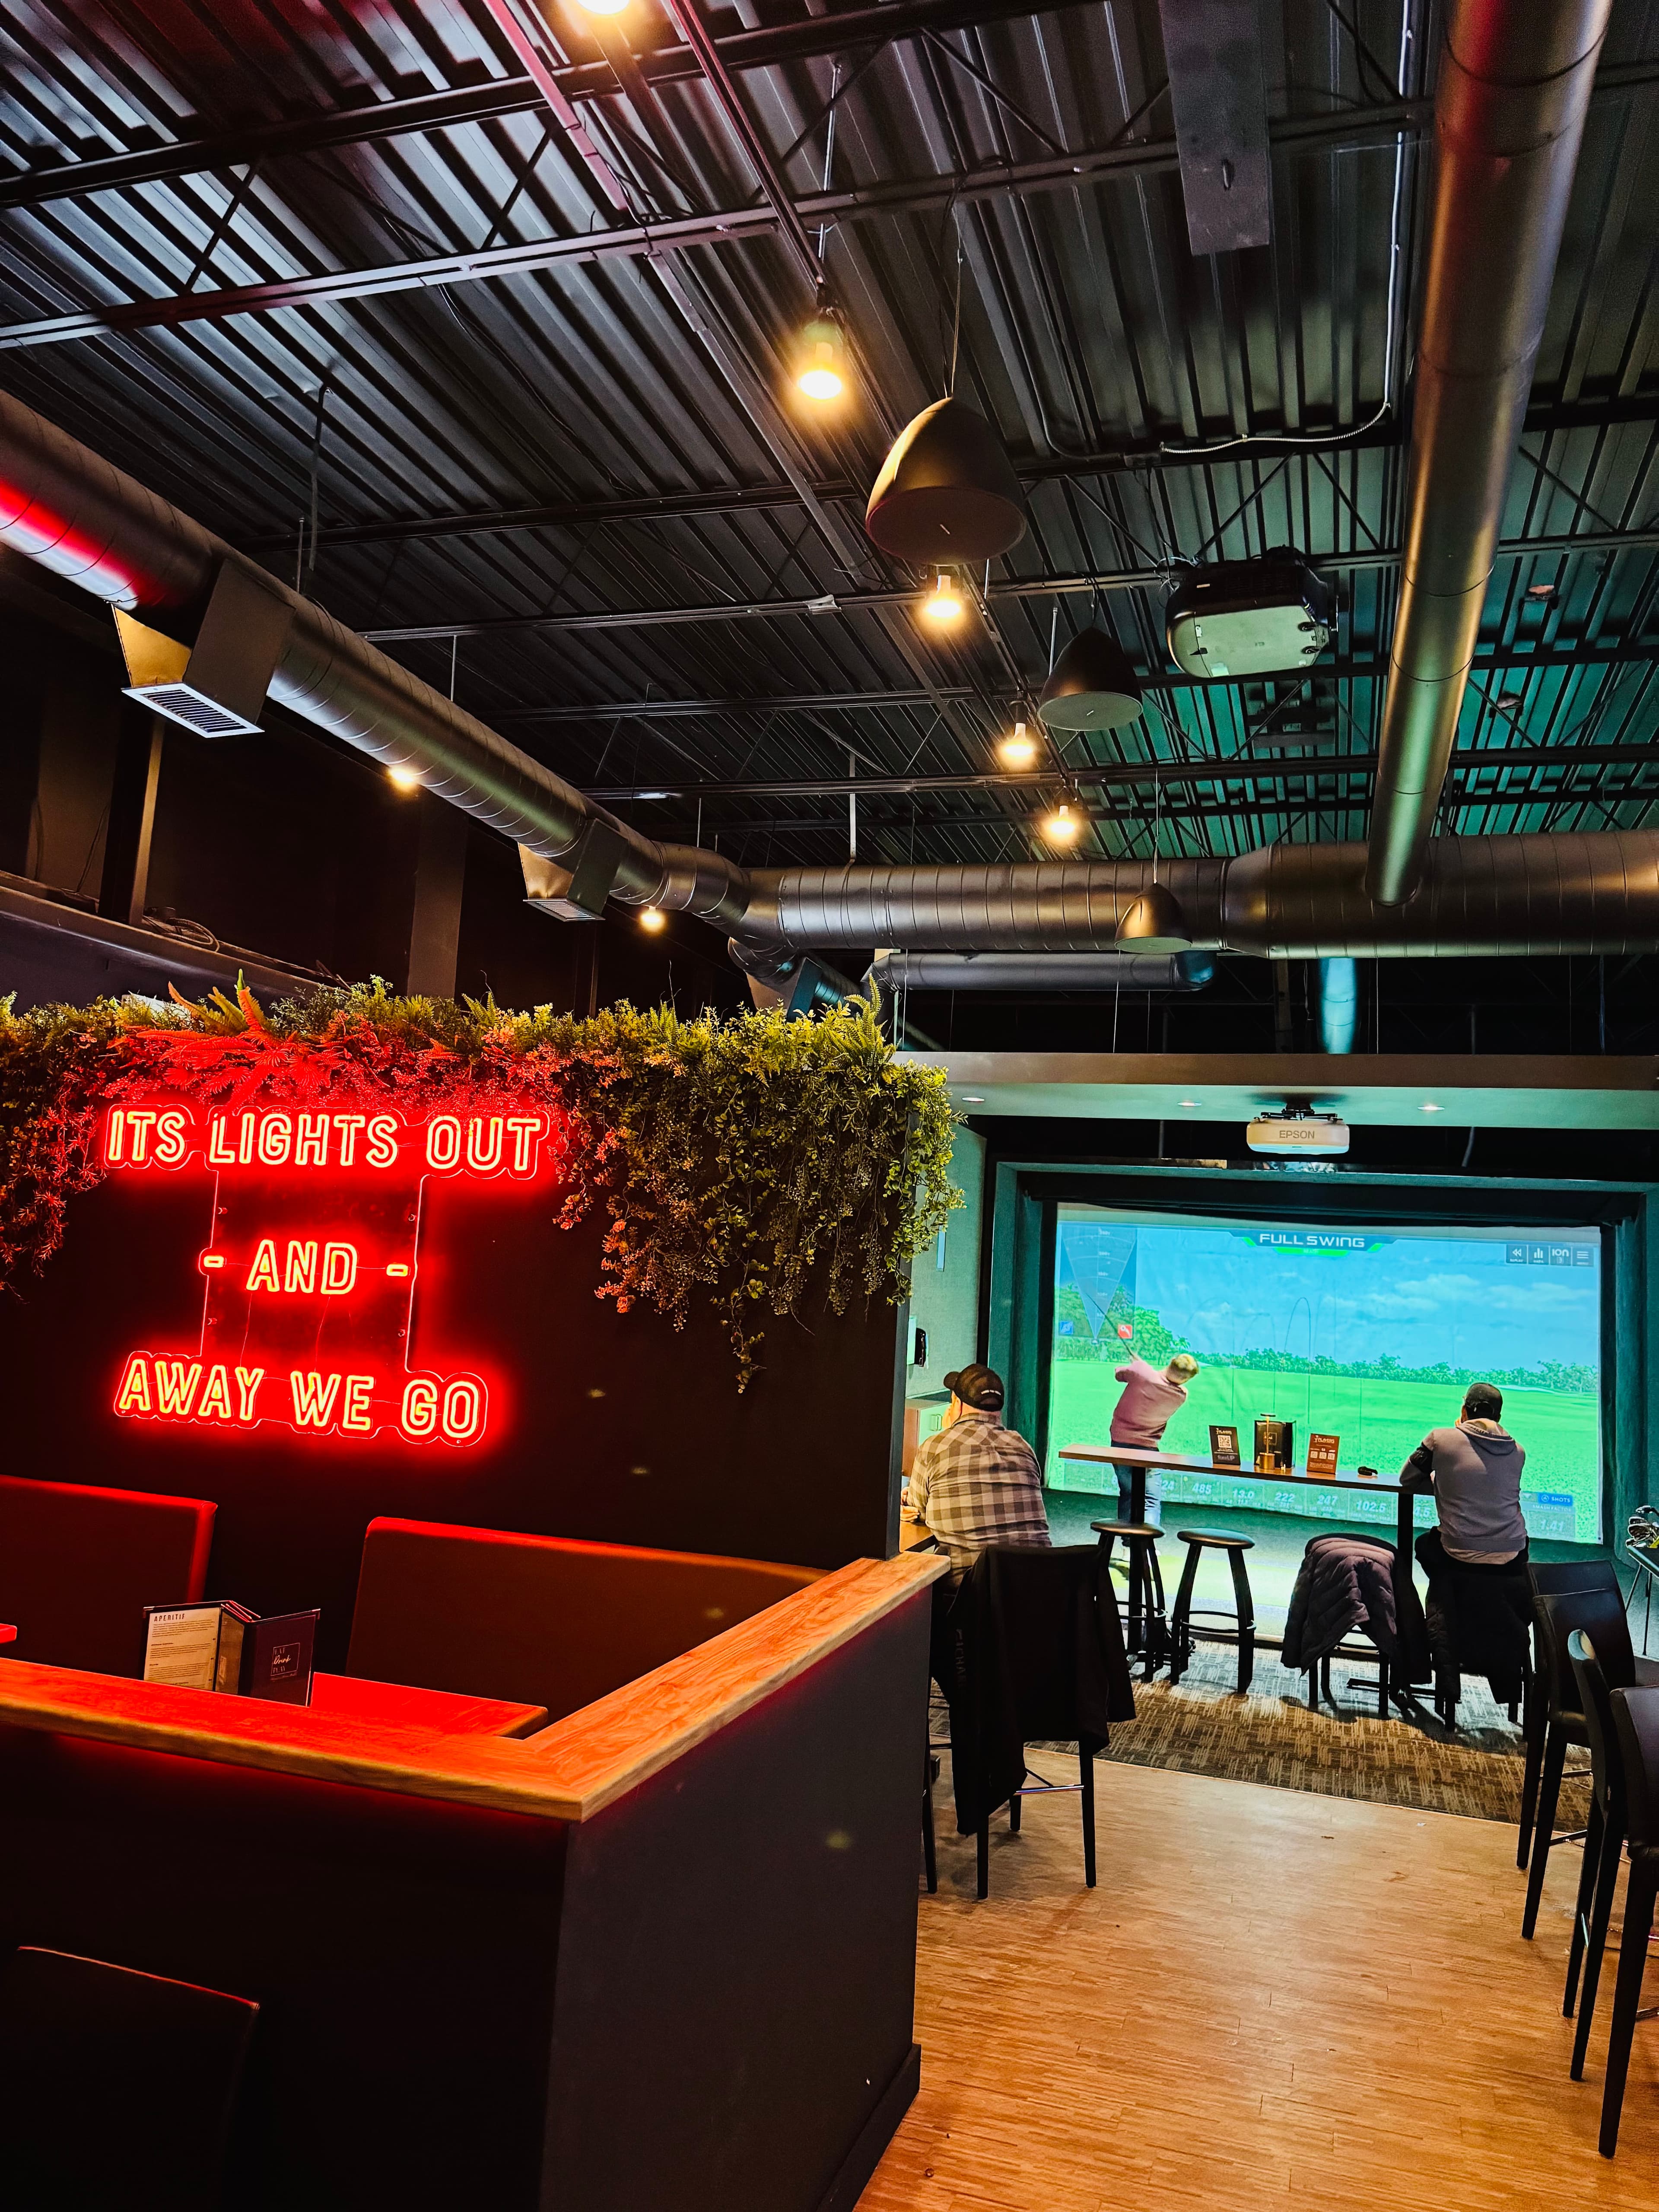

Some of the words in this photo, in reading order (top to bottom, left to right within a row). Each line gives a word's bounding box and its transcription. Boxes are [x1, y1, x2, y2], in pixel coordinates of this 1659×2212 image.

[1279, 1130, 1315, 1139] EPSON
[108, 1111, 186, 1162] ITS
[209, 1112, 400, 1168] LIGHTS
[426, 1115, 541, 1172] OUT
[1260, 1233, 1303, 1245] FULL
[1306, 1236, 1365, 1248] SWING
[246, 1239, 359, 1295] AND
[119, 1359, 264, 1421] AWAY
[290, 1371, 374, 1431] WE
[401, 1379, 480, 1439] GO
[1192, 1483, 1211, 1494] 485
[1233, 1489, 1254, 1499] 13.0
[1275, 1493, 1295, 1502] 222
[1317, 1494, 1338, 1505] 247
[154, 1613, 185, 1622] APERITIF
